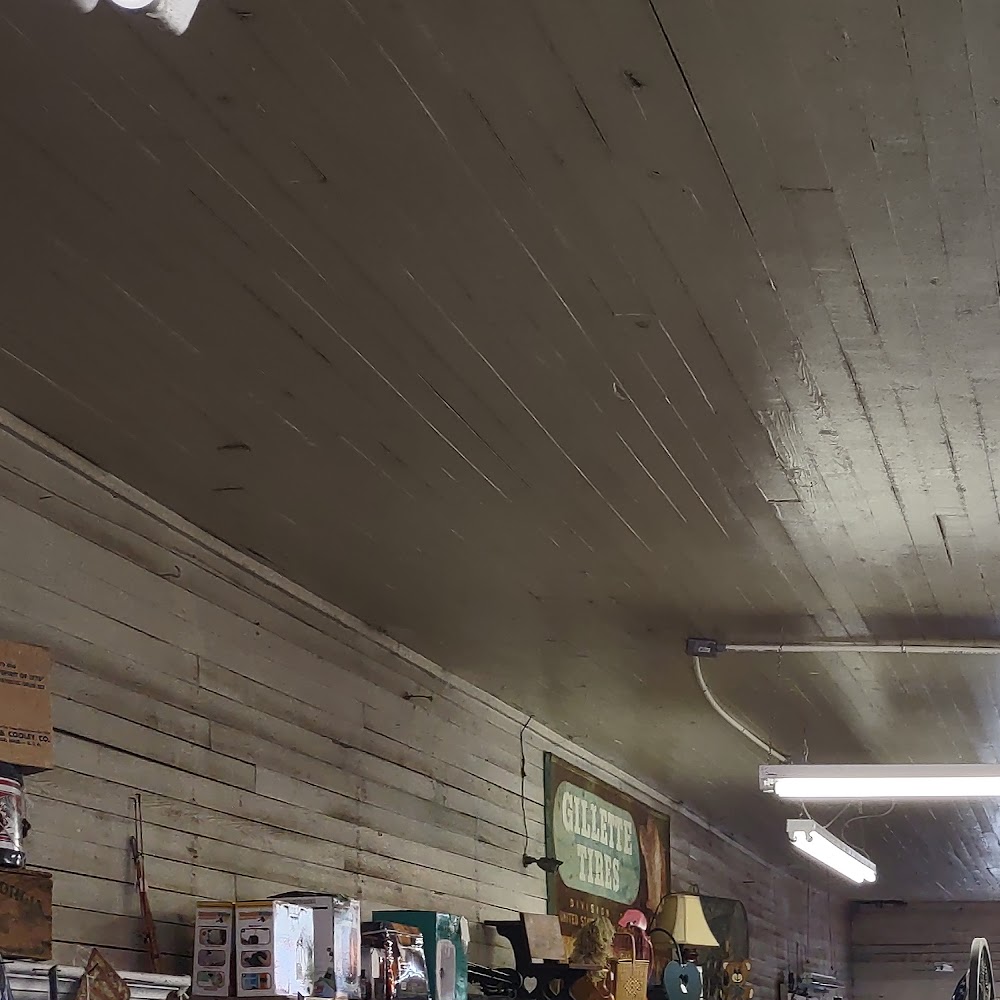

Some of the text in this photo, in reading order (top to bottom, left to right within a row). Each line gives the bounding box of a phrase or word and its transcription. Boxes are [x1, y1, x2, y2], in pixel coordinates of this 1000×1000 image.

[562, 791, 633, 855] GILLETTE
[576, 843, 620, 892] TIRES
[569, 897, 610, 918] DIVISION
